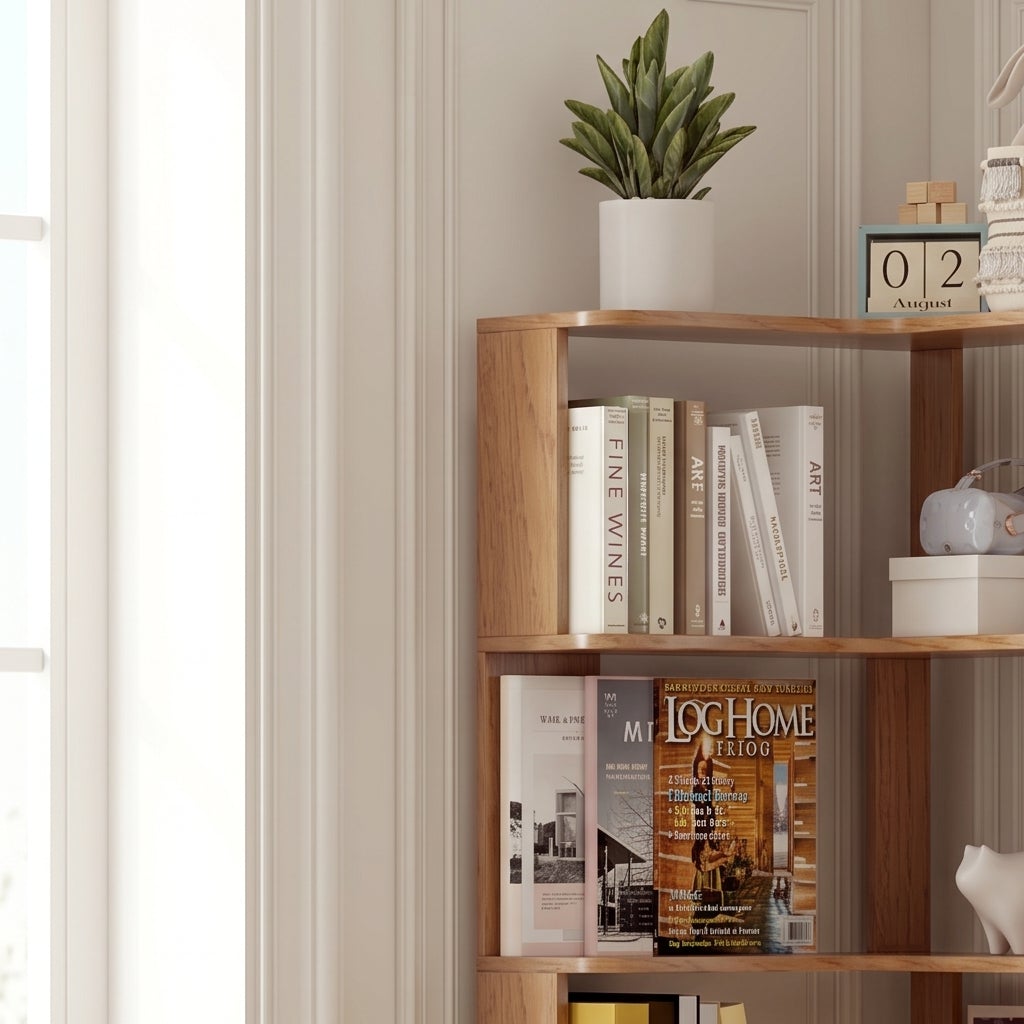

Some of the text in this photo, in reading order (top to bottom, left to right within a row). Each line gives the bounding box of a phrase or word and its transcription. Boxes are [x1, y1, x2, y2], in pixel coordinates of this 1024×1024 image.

[893, 297, 953, 311] August
[608, 438, 624, 498] FINE
[809, 460, 822, 496] ART
[608, 513, 624, 603] WINES
[716, 741, 771, 757] FRIOG
